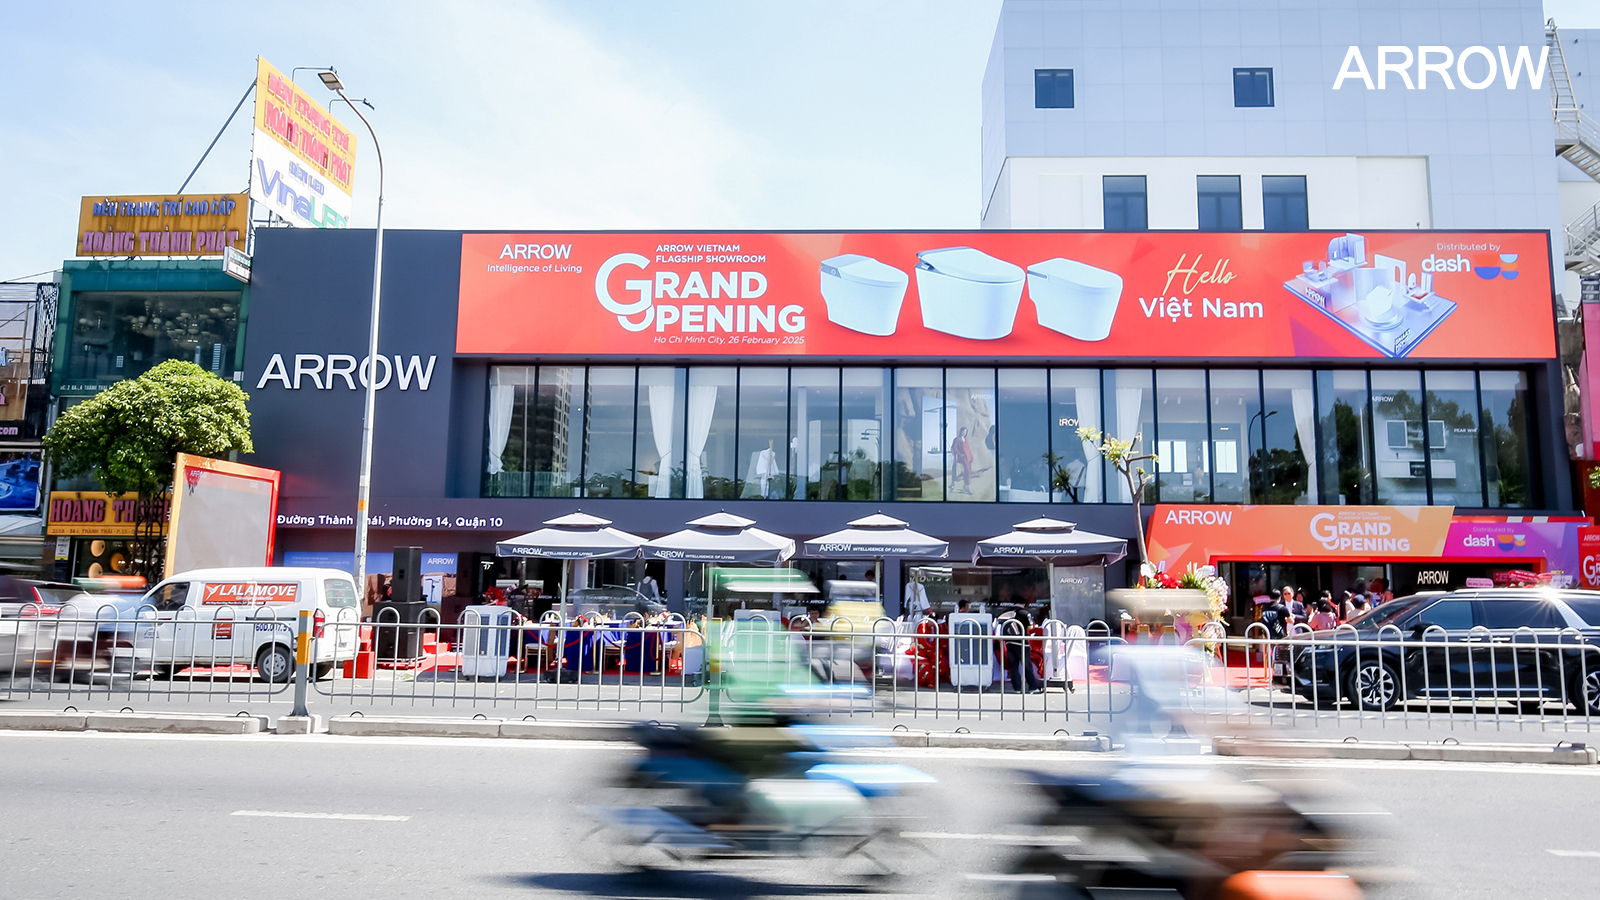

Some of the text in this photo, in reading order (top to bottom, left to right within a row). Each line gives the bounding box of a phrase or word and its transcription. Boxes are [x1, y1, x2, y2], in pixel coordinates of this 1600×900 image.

[295, 94, 331, 137] TRANG
[333, 125, 350, 152] TRÍ
[309, 174, 324, 196] LED
[93, 195, 235, 217] ĐÈN TRANG TRÍ CAO CẤP
[82, 225, 239, 252] HOÀNG THÀNH PHÁT
[499, 243, 572, 259] ARROW
[1489, 243, 1501, 252] by
[487, 264, 582, 274] Intelligence of Living
[1421, 253, 1471, 272] dash
[1162, 253, 1237, 296] Hello
[595, 252, 768, 315] GRAND
[1138, 296, 1263, 322] Việt Nam
[617, 304, 806, 333] OPENING
[708, 336, 726, 345] City,
[741, 336, 780, 345] February
[256, 354, 437, 390] ARROW
[277, 515, 315, 526] Đường
[319, 515, 354, 525] Thành
[388, 516, 432, 528] Phường
[436, 517, 452, 528] 14,
[456, 517, 486, 529] Quận
[490, 518, 504, 527] 10
[1165, 510, 1232, 526] ARROW
[1310, 512, 1392, 542] GRAND
[819, 544, 852, 552] ARROW
[1322, 537, 1410, 552] OPENING
[1463, 534, 1495, 547] dash
[1417, 570, 1449, 585] ARROW
[219, 584, 297, 596] LALAMOVE
